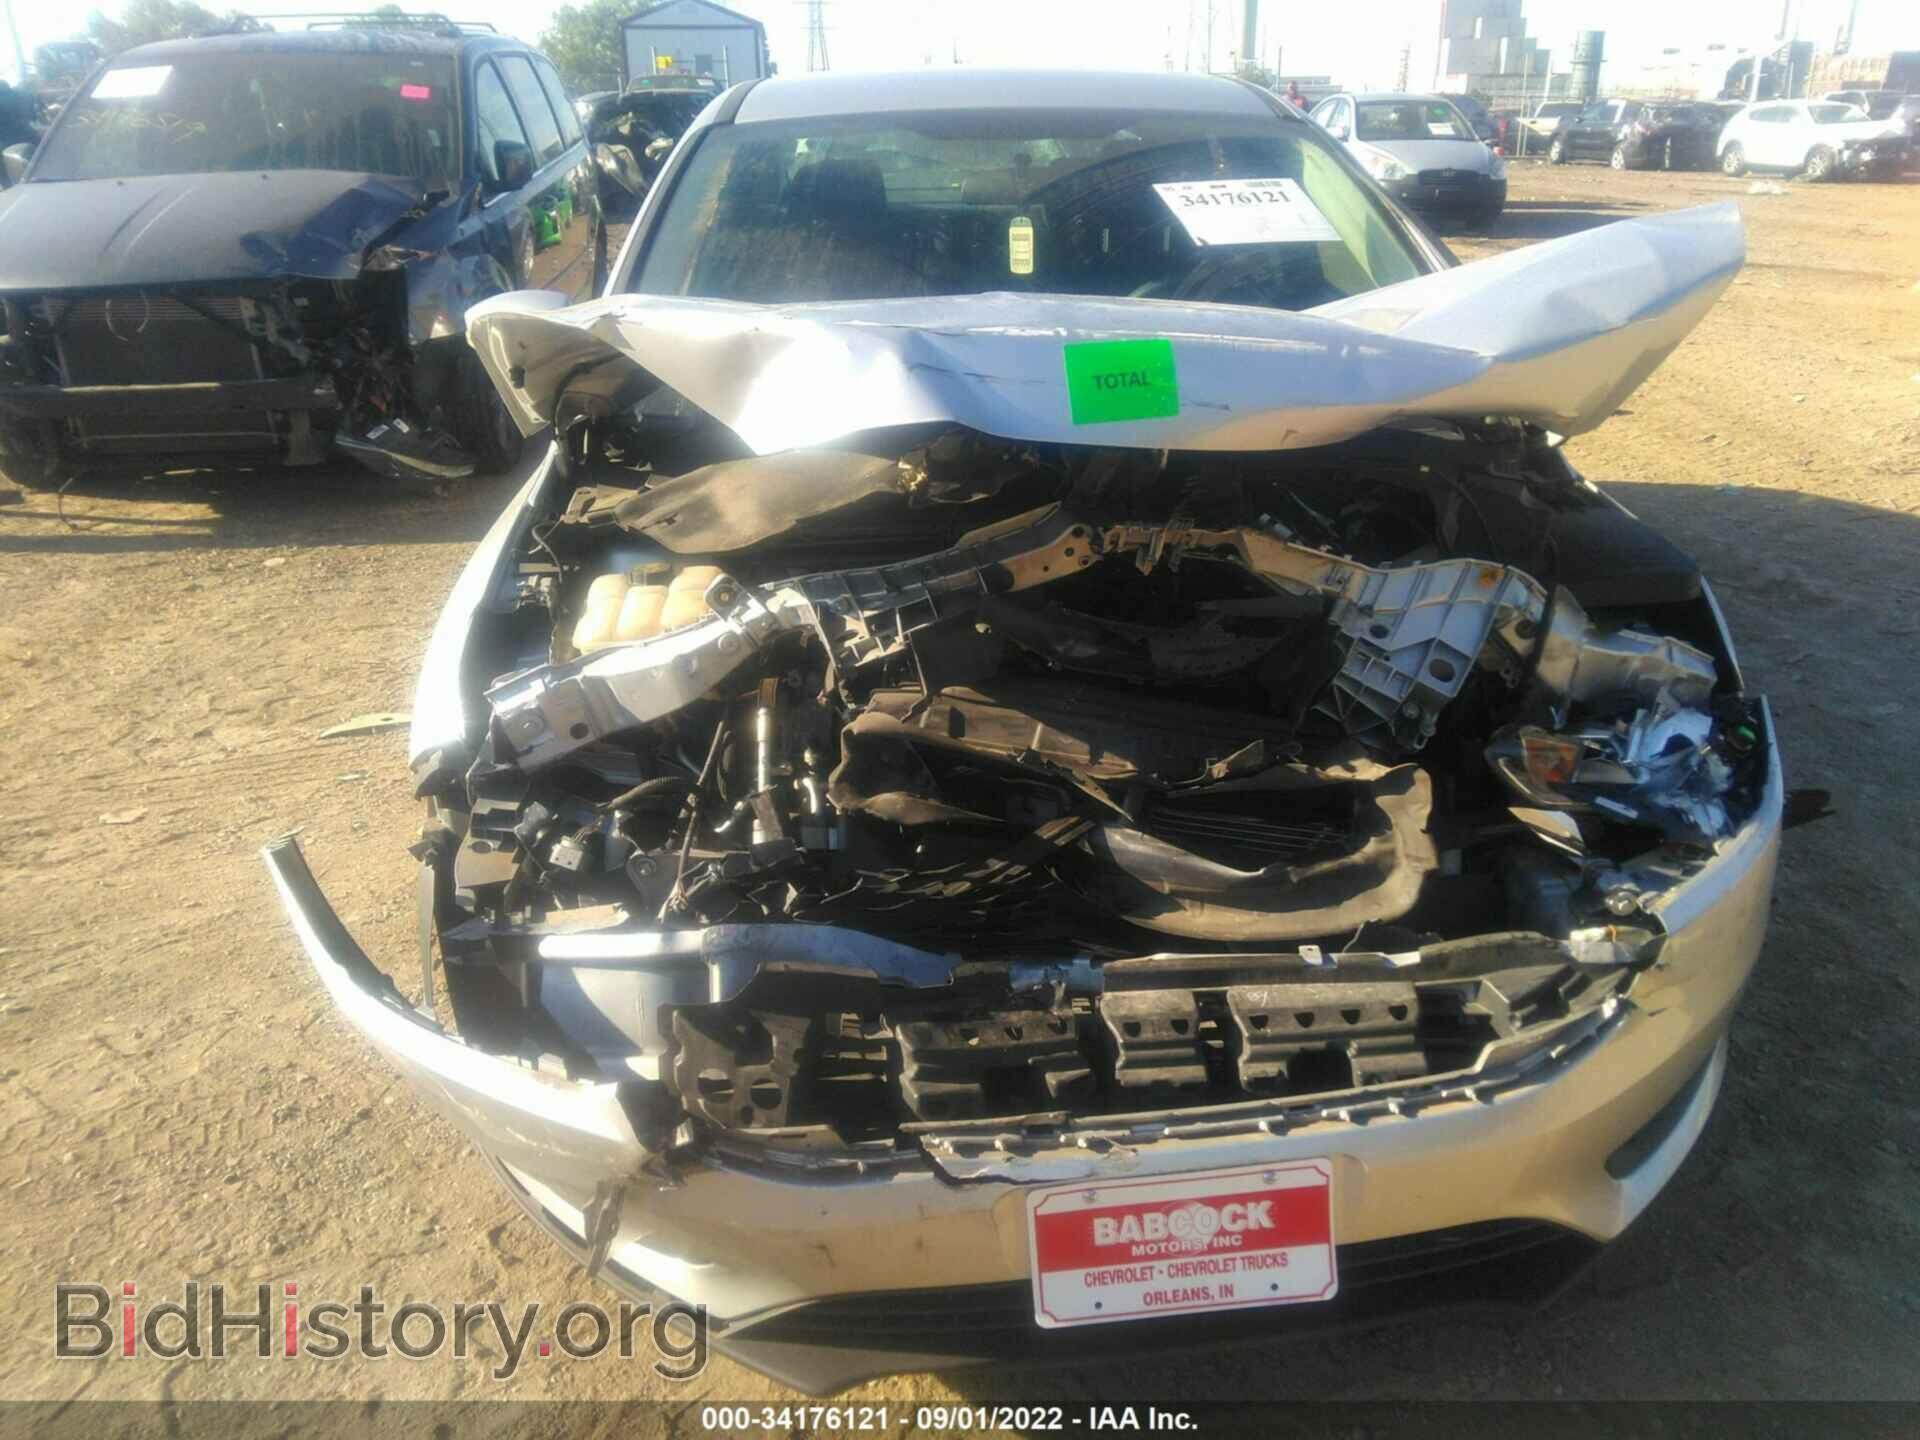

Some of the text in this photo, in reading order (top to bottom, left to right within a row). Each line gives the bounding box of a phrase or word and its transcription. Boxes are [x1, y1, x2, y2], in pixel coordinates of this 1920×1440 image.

[1092, 371, 1151, 390] TOTAL
[1093, 1200, 1275, 1246] BABCOCK
[1213, 1234, 1243, 1248] INC
[1084, 1252, 1288, 1288] CHEVROLET CHEVROLET TRUCKS
[1142, 1284, 1235, 1306] ORLEANS, IN
